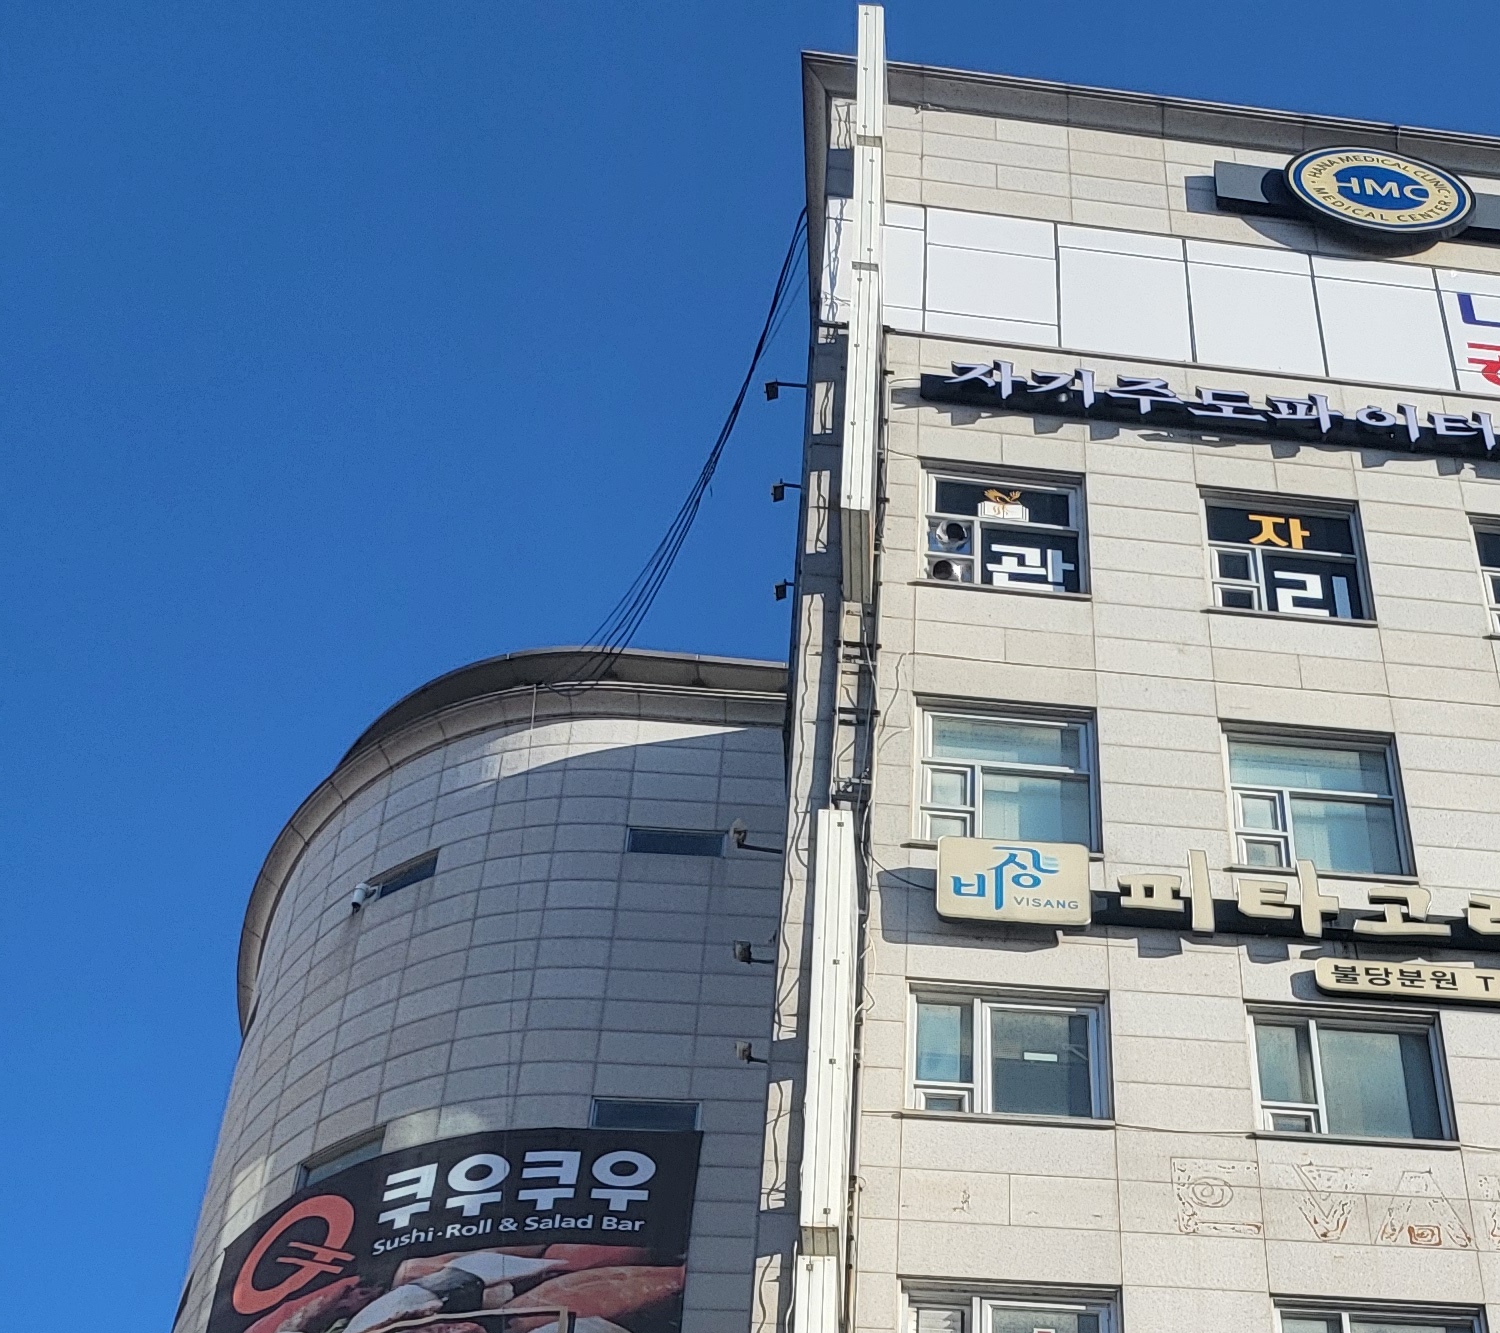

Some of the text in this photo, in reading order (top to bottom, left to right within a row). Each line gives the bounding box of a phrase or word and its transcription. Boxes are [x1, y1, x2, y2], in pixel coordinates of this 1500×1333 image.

[1307, 155, 1451, 199] HANA MEDICAL CLINIC
[1335, 176, 1430, 202] HMC
[1313, 185, 1453, 223] MEDICAL CENTER
[950, 845, 1060, 911] 비상
[1013, 894, 1080, 911] VISANG
[1330, 963, 1459, 992] 불당분원
[377, 1149, 657, 1231] 쿠우쿠우
[497, 1215, 520, 1234] &
[523, 1213, 594, 1233] Salad
[601, 1214, 646, 1234] Bar
